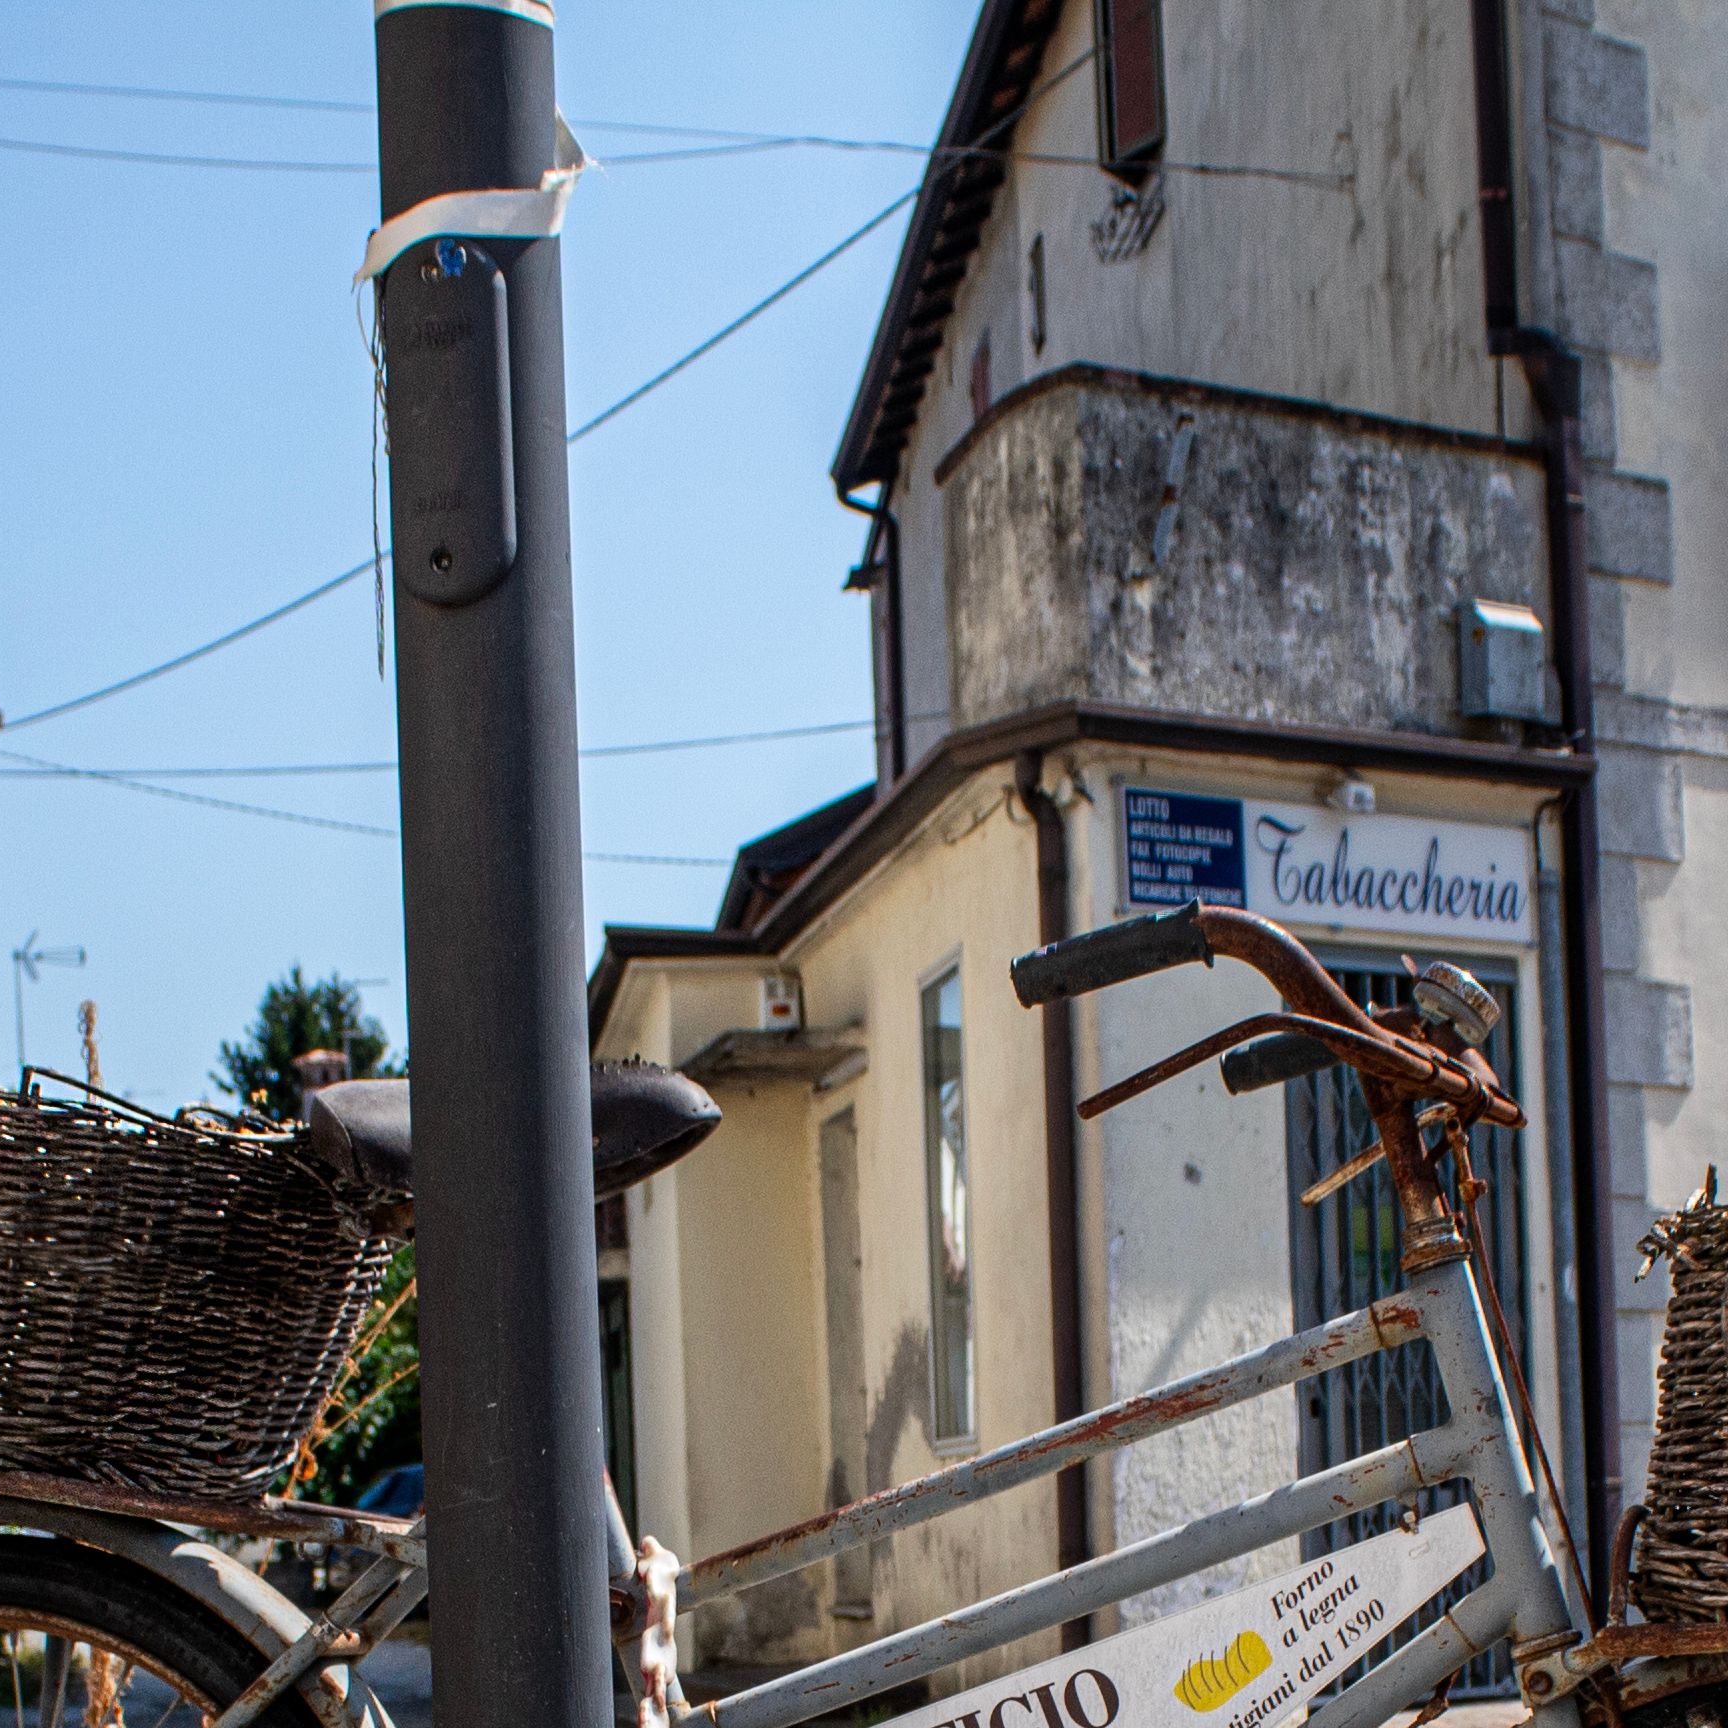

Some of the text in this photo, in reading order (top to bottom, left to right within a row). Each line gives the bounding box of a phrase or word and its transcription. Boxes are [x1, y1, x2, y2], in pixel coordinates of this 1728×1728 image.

[1129, 795, 1170, 820] LOTTO
[1131, 841, 1150, 860] FAX
[1257, 815, 1525, 924] Tabaccheria
[1270, 1561, 1334, 1622] Forno
[1282, 1574, 1360, 1648] a legna
[1299, 1641, 1334, 1683] dal
[1335, 1598, 1385, 1649] 1890
